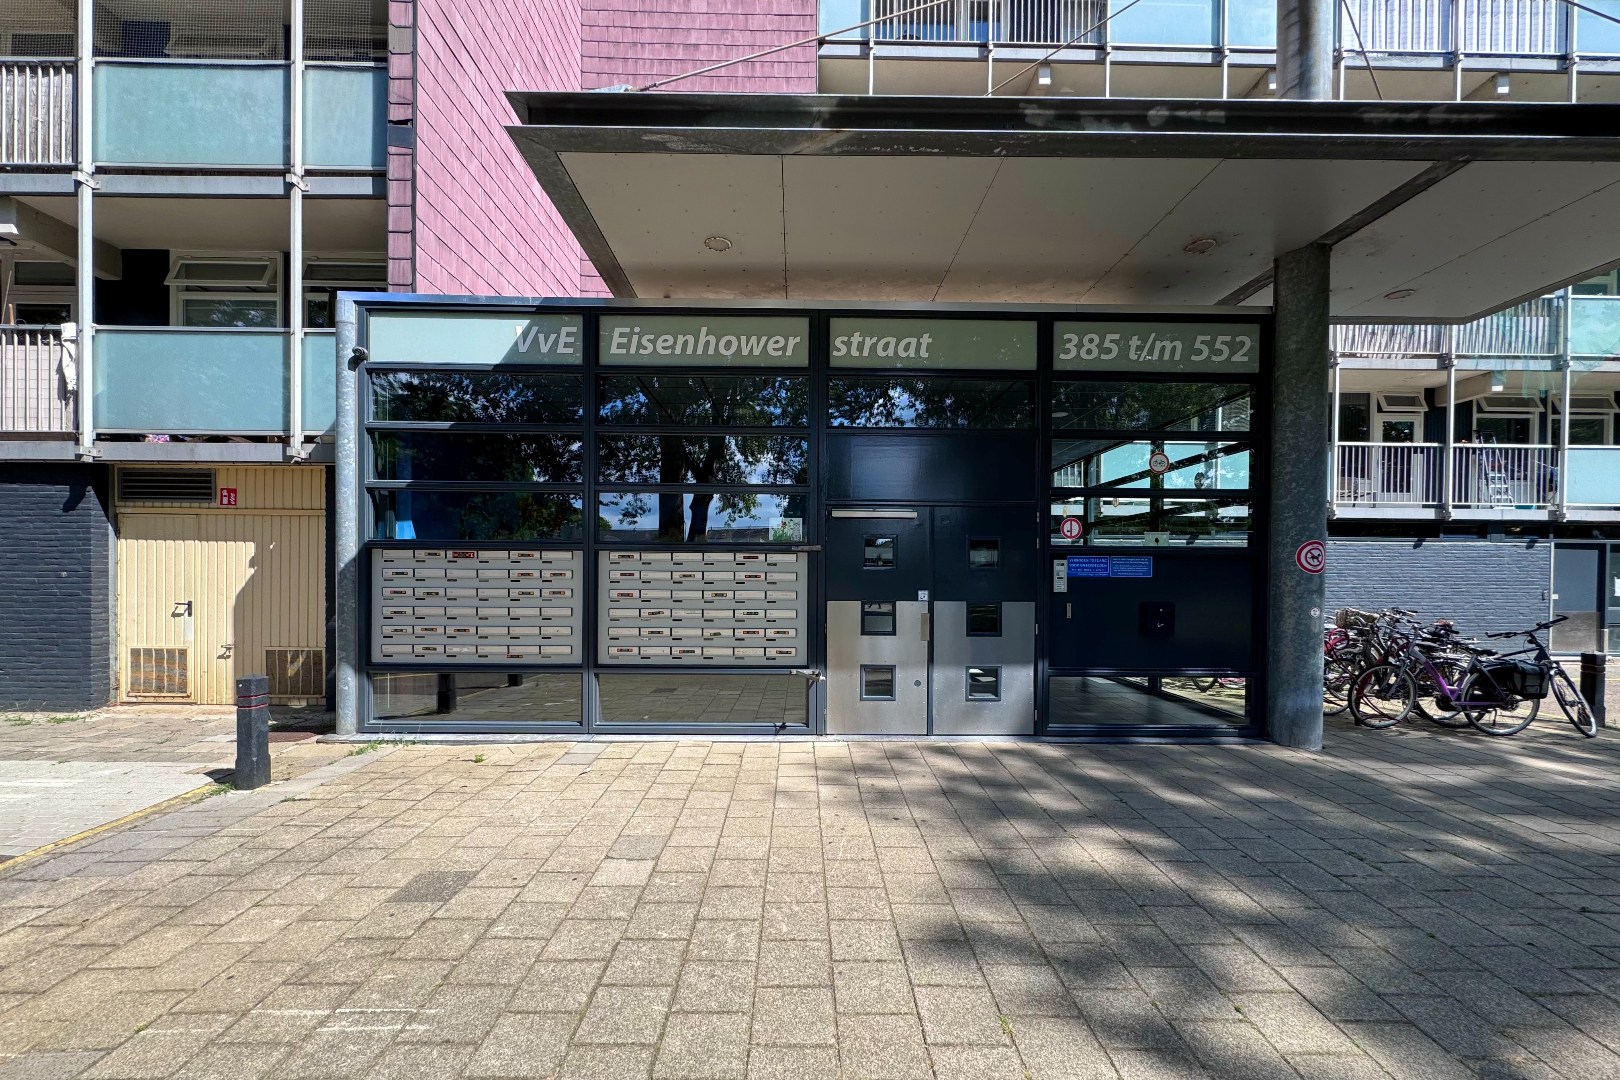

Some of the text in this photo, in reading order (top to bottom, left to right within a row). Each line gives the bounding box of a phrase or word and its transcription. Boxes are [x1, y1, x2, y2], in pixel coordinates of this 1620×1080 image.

[515, 326, 1251, 362] VvE Eisenhower straat 385 t/m 552
